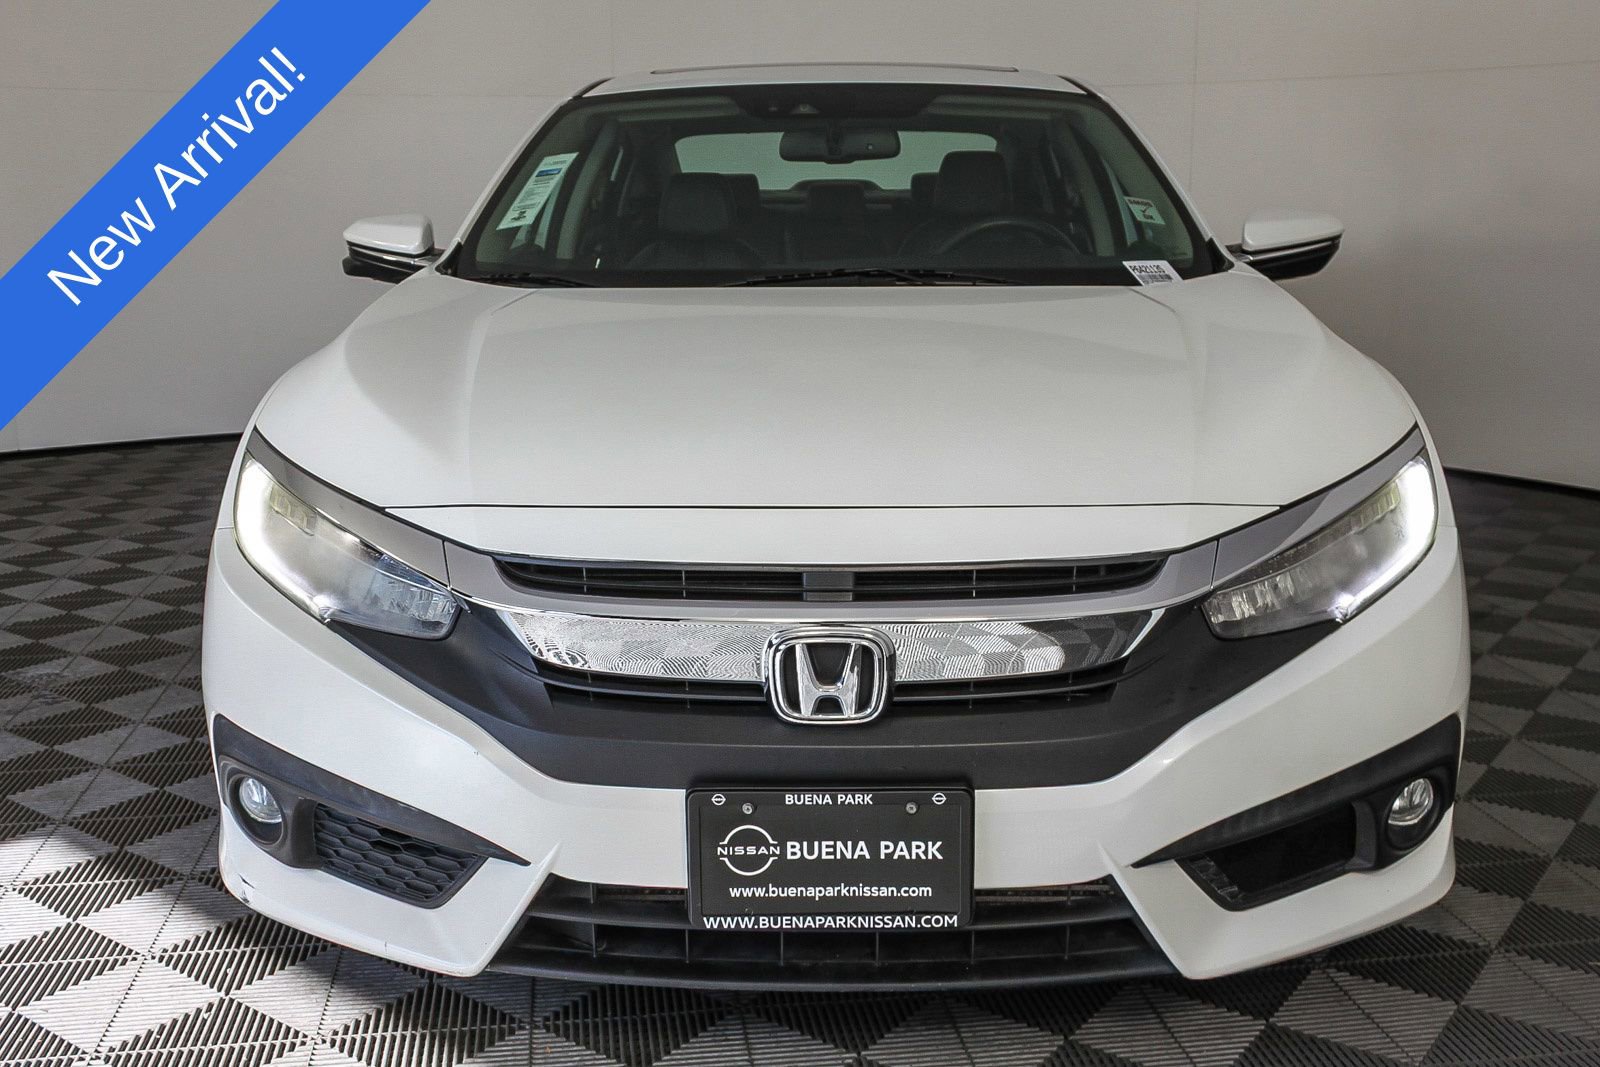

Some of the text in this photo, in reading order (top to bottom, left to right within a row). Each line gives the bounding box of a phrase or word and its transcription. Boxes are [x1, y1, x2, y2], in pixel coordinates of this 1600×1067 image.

[784, 793, 873, 805] BUENA PARK
[717, 840, 944, 860] NISSAN BUENA PARK
[728, 882, 933, 901] www.buenaparknissan.com
[702, 914, 958, 929] WWW.BUENAPARKNISSAN.COM
